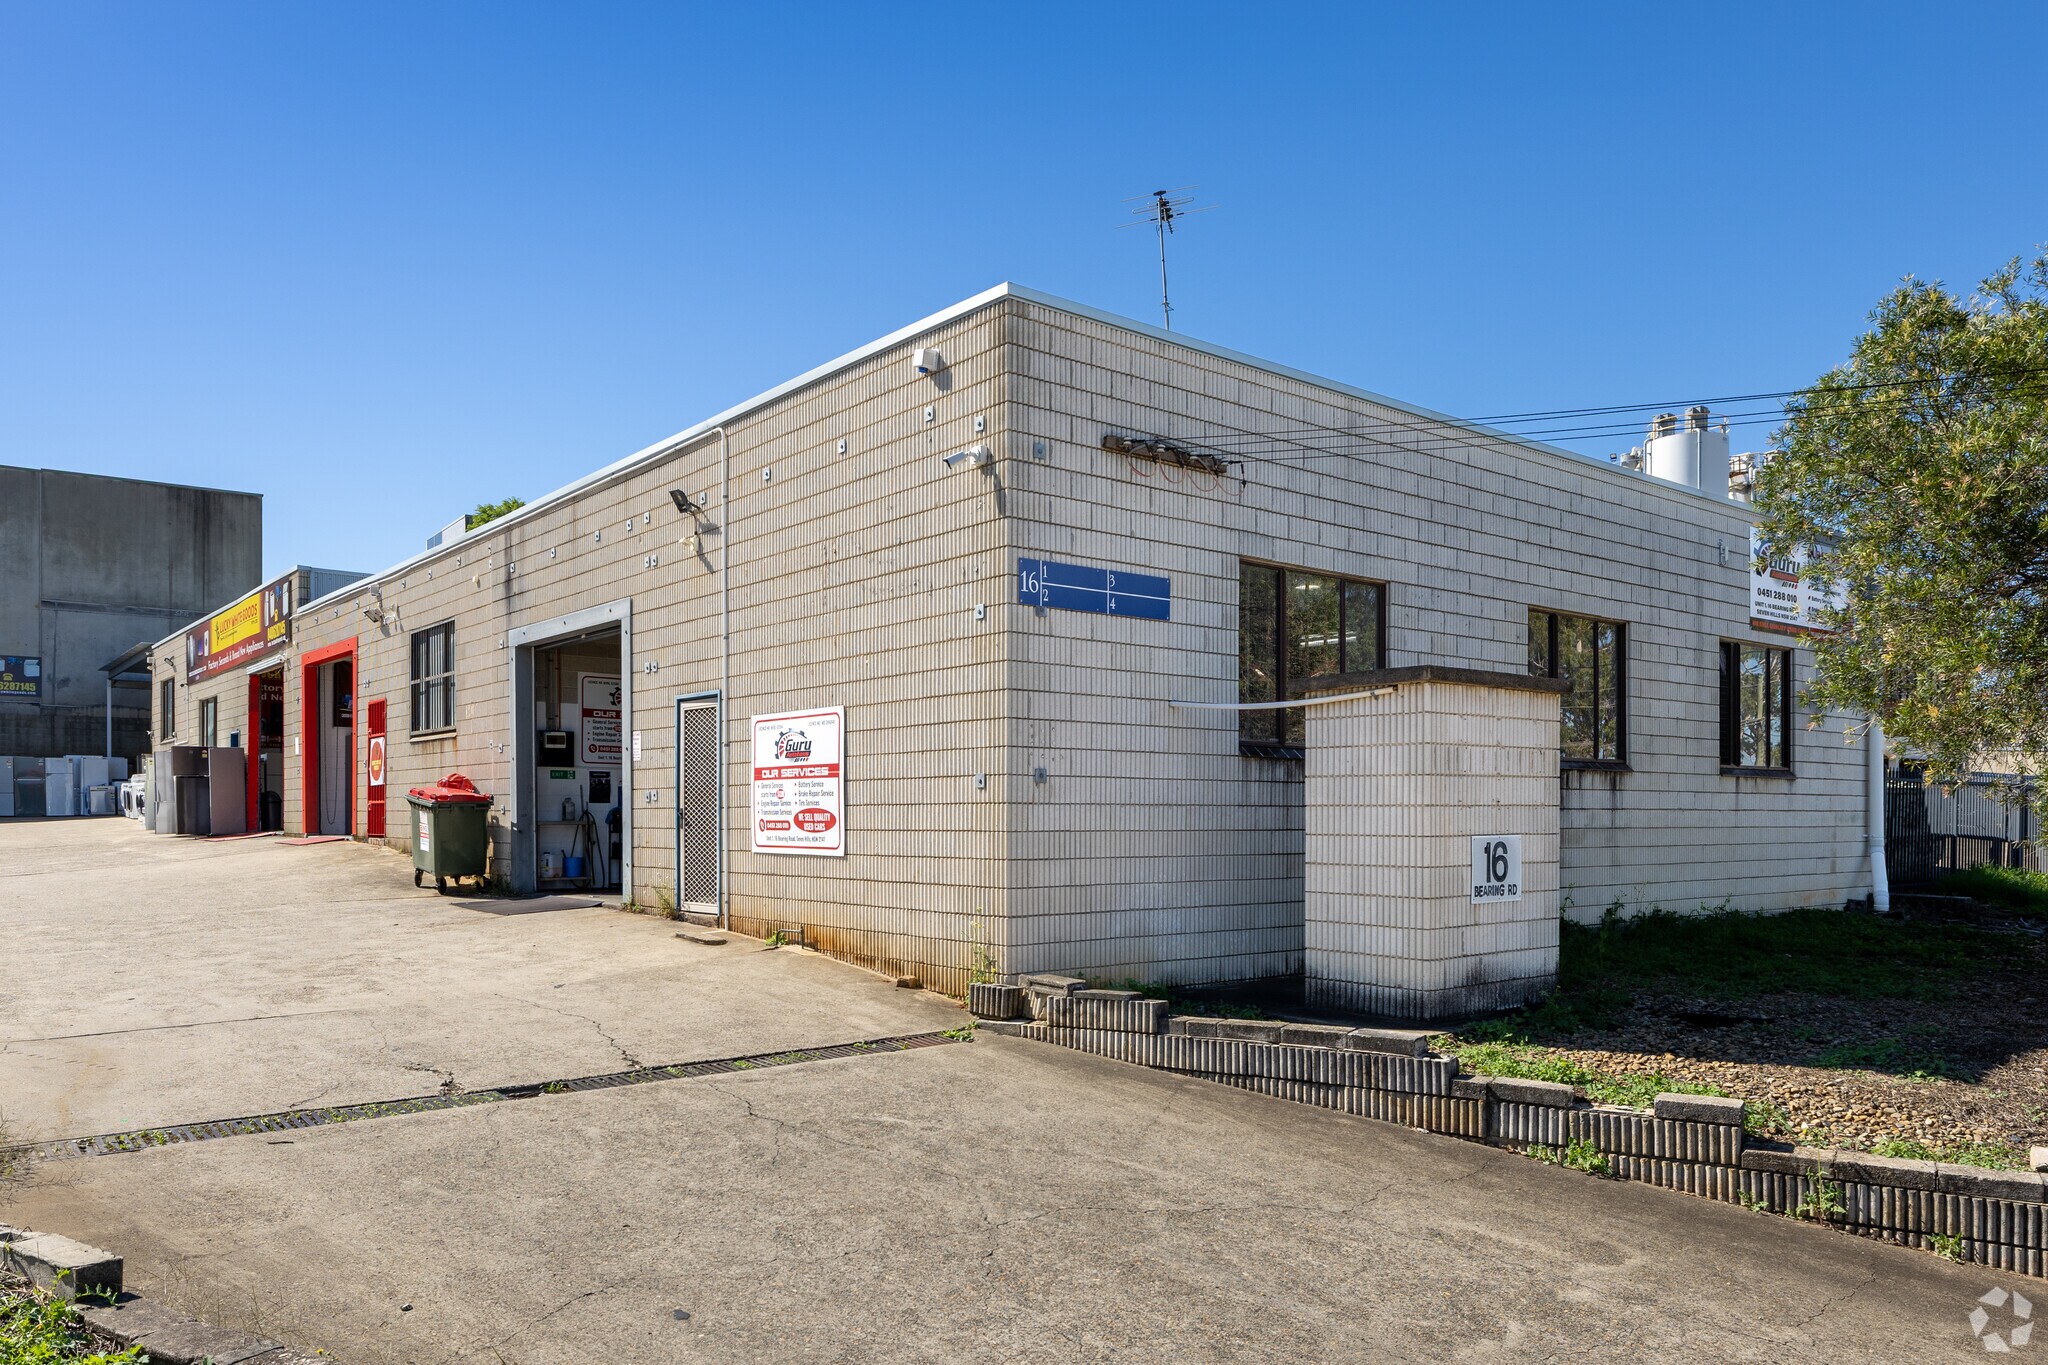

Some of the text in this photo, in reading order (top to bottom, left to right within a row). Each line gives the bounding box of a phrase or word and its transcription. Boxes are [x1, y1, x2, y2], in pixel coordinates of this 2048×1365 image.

[1042, 565, 1048, 578] 1
[1020, 571, 1039, 593] 16
[1110, 574, 1116, 587] 3
[1042, 589, 1048, 602] 2
[1757, 587, 1798, 603] 0451 288 010
[1110, 598, 1116, 610] 4
[1772, 604, 1789, 612] BEARING
[220, 618, 230, 634] LUCKY
[208, 660, 218, 670] Factory
[219, 652, 230, 666] Seconds
[246, 640, 264, 655] Appliances
[785, 739, 812, 752] Guru
[762, 767, 829, 778] OUR SERVICES
[804, 813, 812, 821] SELL
[814, 813, 830, 822] QUALITY
[1484, 841, 1508, 883] 16
[1474, 884, 1517, 897] BEARING RD
